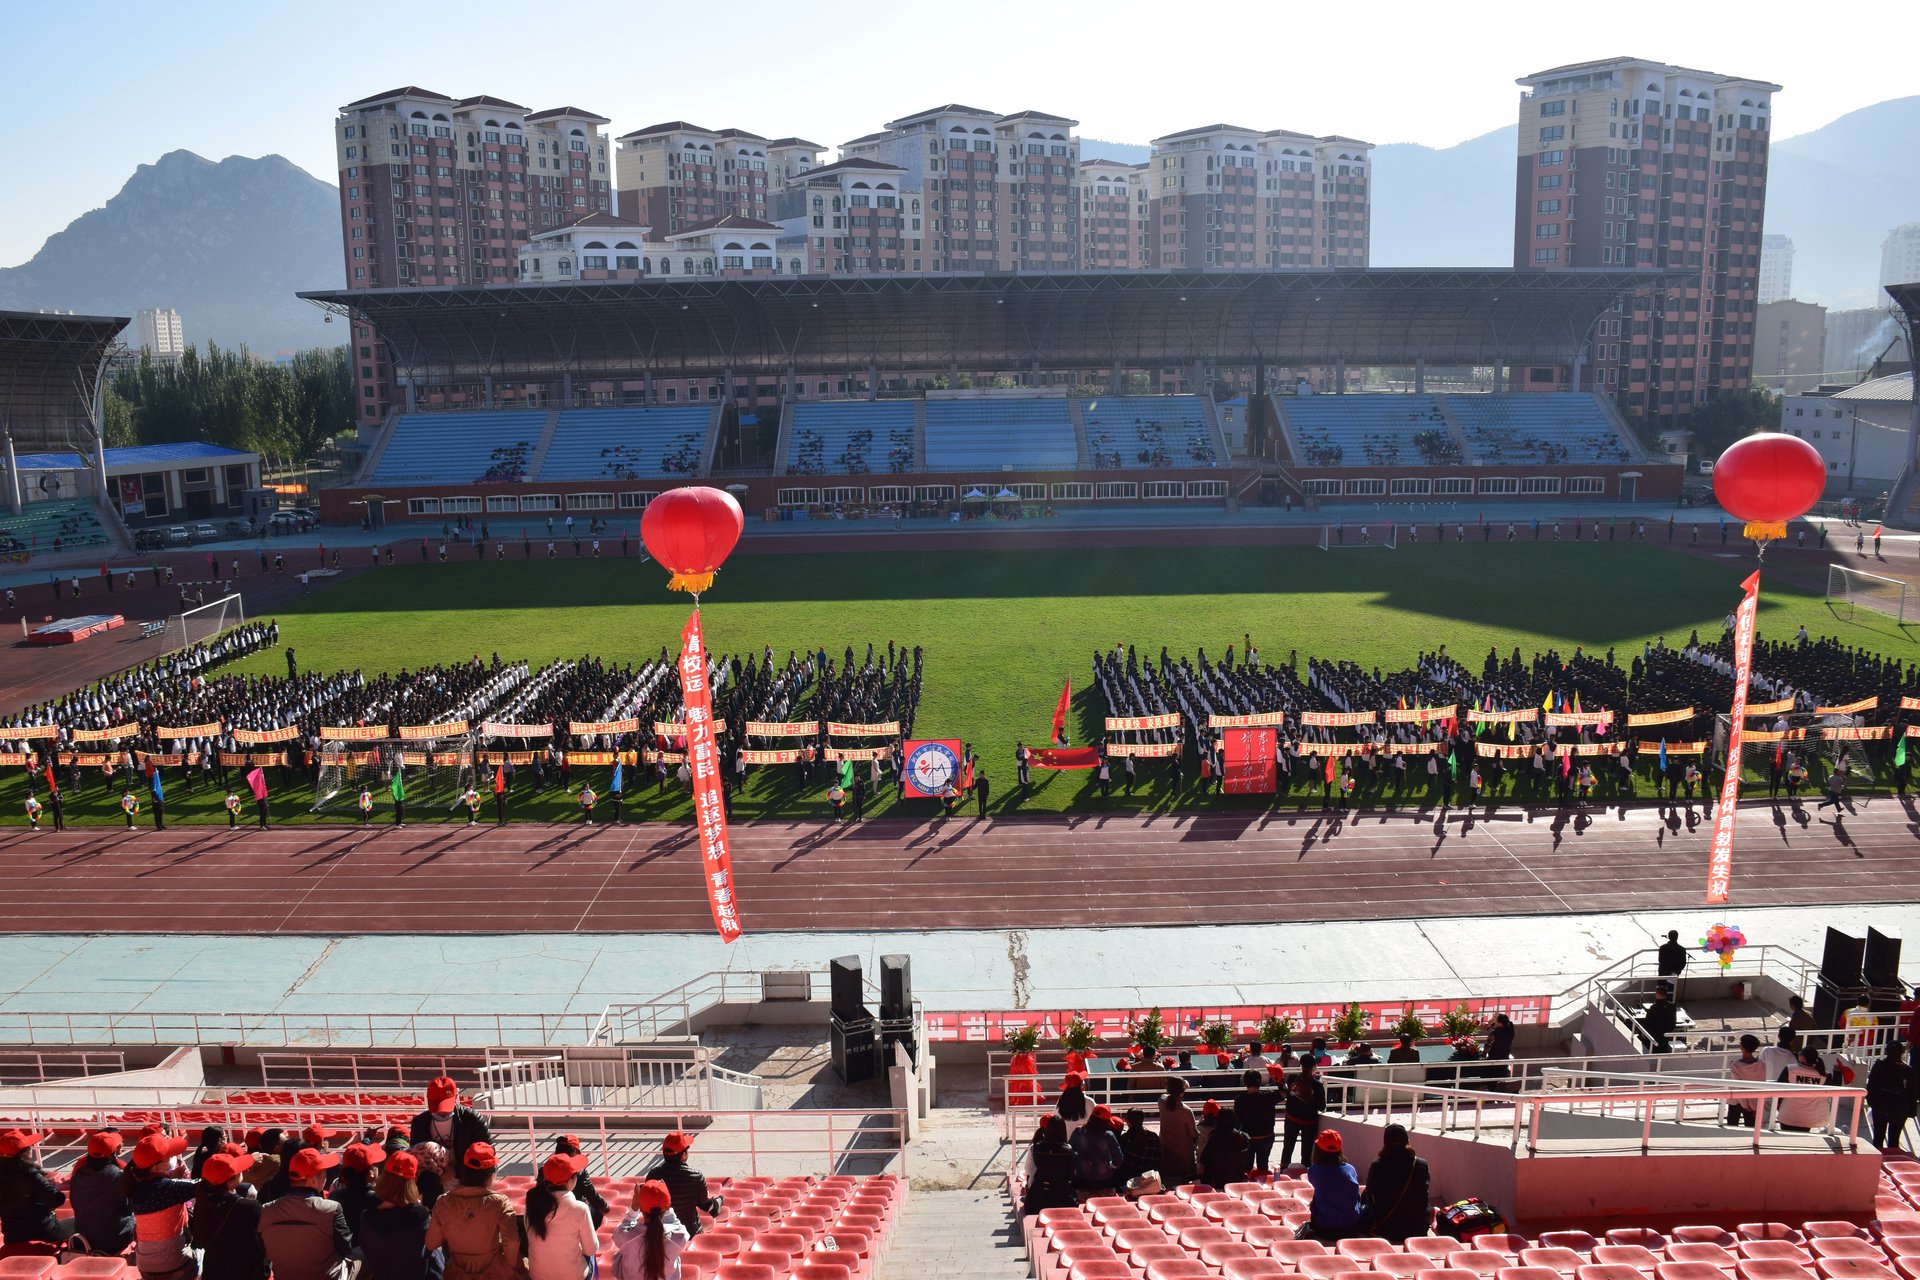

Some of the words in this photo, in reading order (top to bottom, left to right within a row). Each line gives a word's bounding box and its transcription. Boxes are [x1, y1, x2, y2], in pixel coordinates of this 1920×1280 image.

[83, 755, 96, 764] THE
[97, 753, 126, 764] SYTEM
[687, 705, 715, 780] 魅力富民
[746, 752, 777, 763] 天道酬勤
[699, 789, 726, 861] 追逐梦想
[710, 868, 740, 934] 青春起航
[1796, 1075, 1821, 1085] NEW
